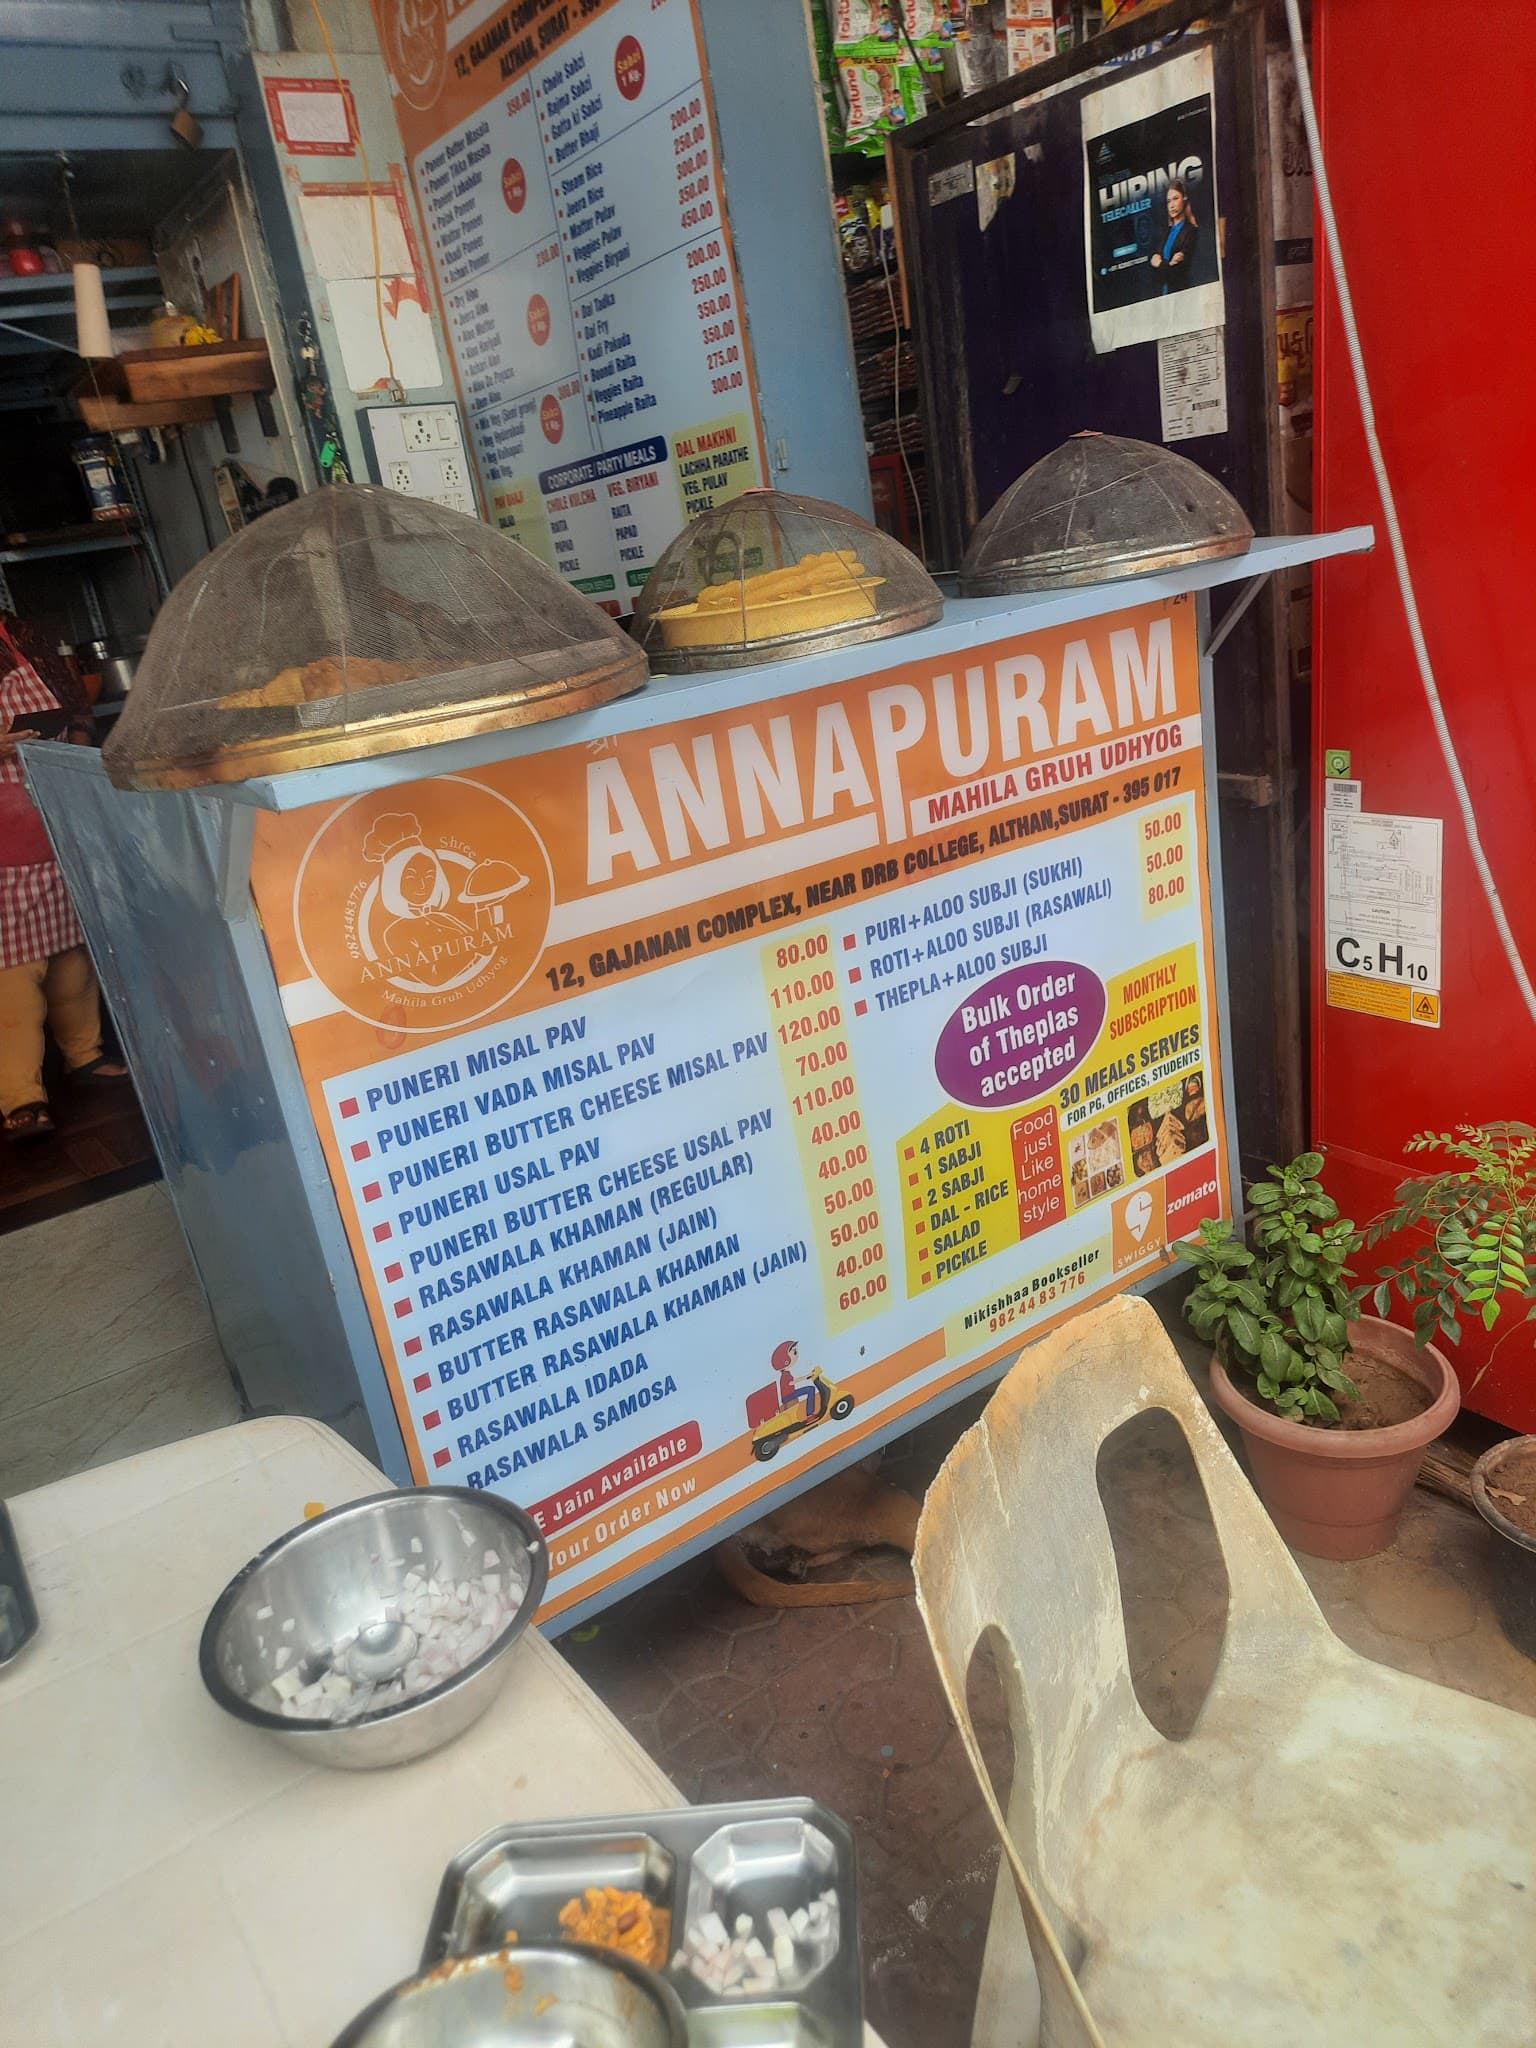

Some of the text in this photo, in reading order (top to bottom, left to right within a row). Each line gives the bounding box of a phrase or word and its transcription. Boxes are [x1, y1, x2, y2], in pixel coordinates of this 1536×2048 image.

[1099, 155, 1204, 211] HIRING
[624, 445, 657, 467] MEALS
[676, 426, 737, 458] DAL MAKHNI
[586, 617, 1178, 886] ANNAPURAM
[928, 724, 1182, 824] MAHILA GRUH UDHYOG
[438, 836, 477, 859] Shree
[1145, 811, 1182, 841] 50.00
[546, 962, 585, 991] 12,
[589, 925, 692, 978] GAJANAN
[697, 892, 802, 943] COMPLEX,
[806, 872, 857, 908] NEAR
[861, 859, 899, 889] DRB
[903, 832, 985, 875] COLLEGE,
[1123, 780, 1150, 804] 395
[1153, 766, 1182, 792] 017
[1146, 845, 1184, 873] 50.00
[864, 856, 1083, 945] PURI+ALOO SUBJI (SUKHI)
[1148, 875, 1185, 905] 80.00
[360, 923, 515, 984] ANNAPURAM
[776, 934, 829, 968] 80.00
[870, 878, 1112, 979] ROTI+ALOO SUBJI (RASAWALI)
[382, 956, 509, 1008] Mahila Gruh Udhyog
[770, 970, 834, 1008] 110.00
[875, 934, 1048, 1012] THEPLA+ALOO SUBJI
[1123, 963, 1177, 1005] MONTHLY
[777, 1006, 841, 1044] 120.00
[961, 971, 1076, 1033] Bulk Order
[1109, 984, 1196, 1040] SUBSCRIPTION
[795, 1041, 848, 1076] 70.00
[968, 1006, 1079, 1067] of Theplas
[366, 1016, 586, 1112] PUNERI MISAL PAV
[980, 1036, 1076, 1098] accepted
[1060, 1023, 1199, 1109] 30 MEALS SERVES
[1067, 1048, 1200, 1126] FOR PG, OFFICES, STUDENTS
[377, 1033, 656, 1154] PUNERI VADA MISAL PAV
[388, 1032, 768, 1195] PUNERI BUTTER CHEESE MISAL PAV
[792, 1075, 855, 1115] 110.00
[811, 1110, 861, 1145] 40.00
[920, 1119, 970, 1155] 4 ROTI
[1012, 1107, 1053, 1140] Food
[1023, 1132, 1052, 1163] just
[399, 1137, 600, 1235] PUNERI USAL PAV
[818, 1144, 868, 1179] 40.00
[924, 1141, 982, 1180] 1 SABJI
[1021, 1154, 1054, 1181] Like
[409, 1108, 772, 1274] PUNERI BUTTER CHEESE USAL PAV
[824, 1178, 874, 1214] 50.00
[927, 1166, 985, 1207] 2 SABJI
[930, 1180, 1009, 1231] DAL RICE
[1017, 1173, 1062, 1205] home
[1023, 1195, 1060, 1223] style
[1166, 1179, 1217, 1215] zomato
[419, 1151, 753, 1309] RASAWALA KHAMAN (REGULAR)
[829, 1210, 879, 1247] 50.00
[933, 1219, 981, 1255] SALAD
[1117, 1237, 1162, 1268] SWIGGY
[428, 1206, 717, 1346] RASAWALA KHAMAN (JAIN)
[835, 1243, 884, 1278] 40.00
[936, 1240, 987, 1280] PICKLE
[437, 1233, 740, 1384] BUTTER RASAWALA KHAMAN
[839, 1274, 887, 1310] 60.00
[964, 1249, 1100, 1330] Nikishhaa Bookseller
[989, 1271, 1086, 1332] 982 44 83 776
[447, 1240, 807, 1421] BUTTER RASAWALA KHAMAN (JAIN)
[456, 1352, 648, 1458] RASAWALA IDADA
[467, 1375, 677, 1490] RASAWALA SAMOSA
[553, 1488, 594, 1521] Jain
[601, 1437, 687, 1494] Available
[594, 1504, 651, 1543] Order
[655, 1478, 697, 1509] Now
